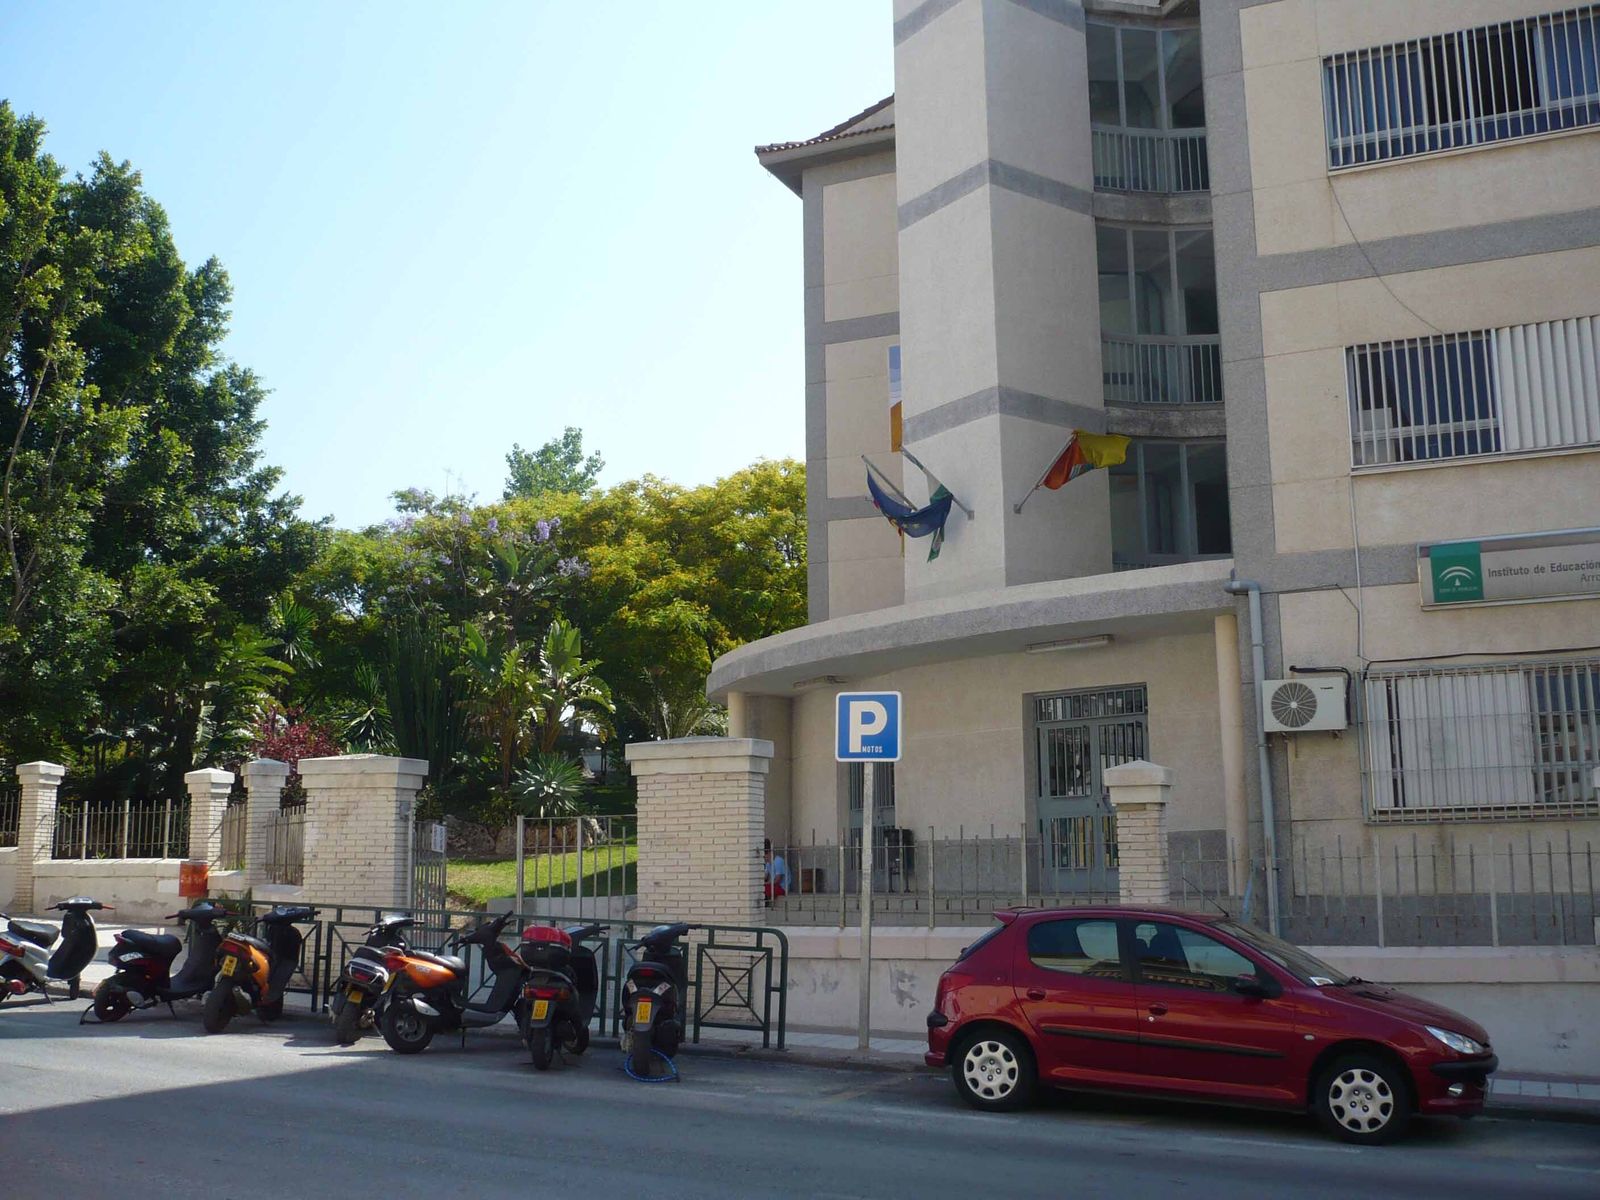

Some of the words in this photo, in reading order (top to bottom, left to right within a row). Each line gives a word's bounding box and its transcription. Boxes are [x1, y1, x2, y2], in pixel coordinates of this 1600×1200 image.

[1488, 565, 1530, 578] Instituto
[1534, 563, 1546, 574] de
[1550, 559, 1600, 573] Educación
[849, 700, 888, 754] P
[861, 745, 883, 753] MOTOS
